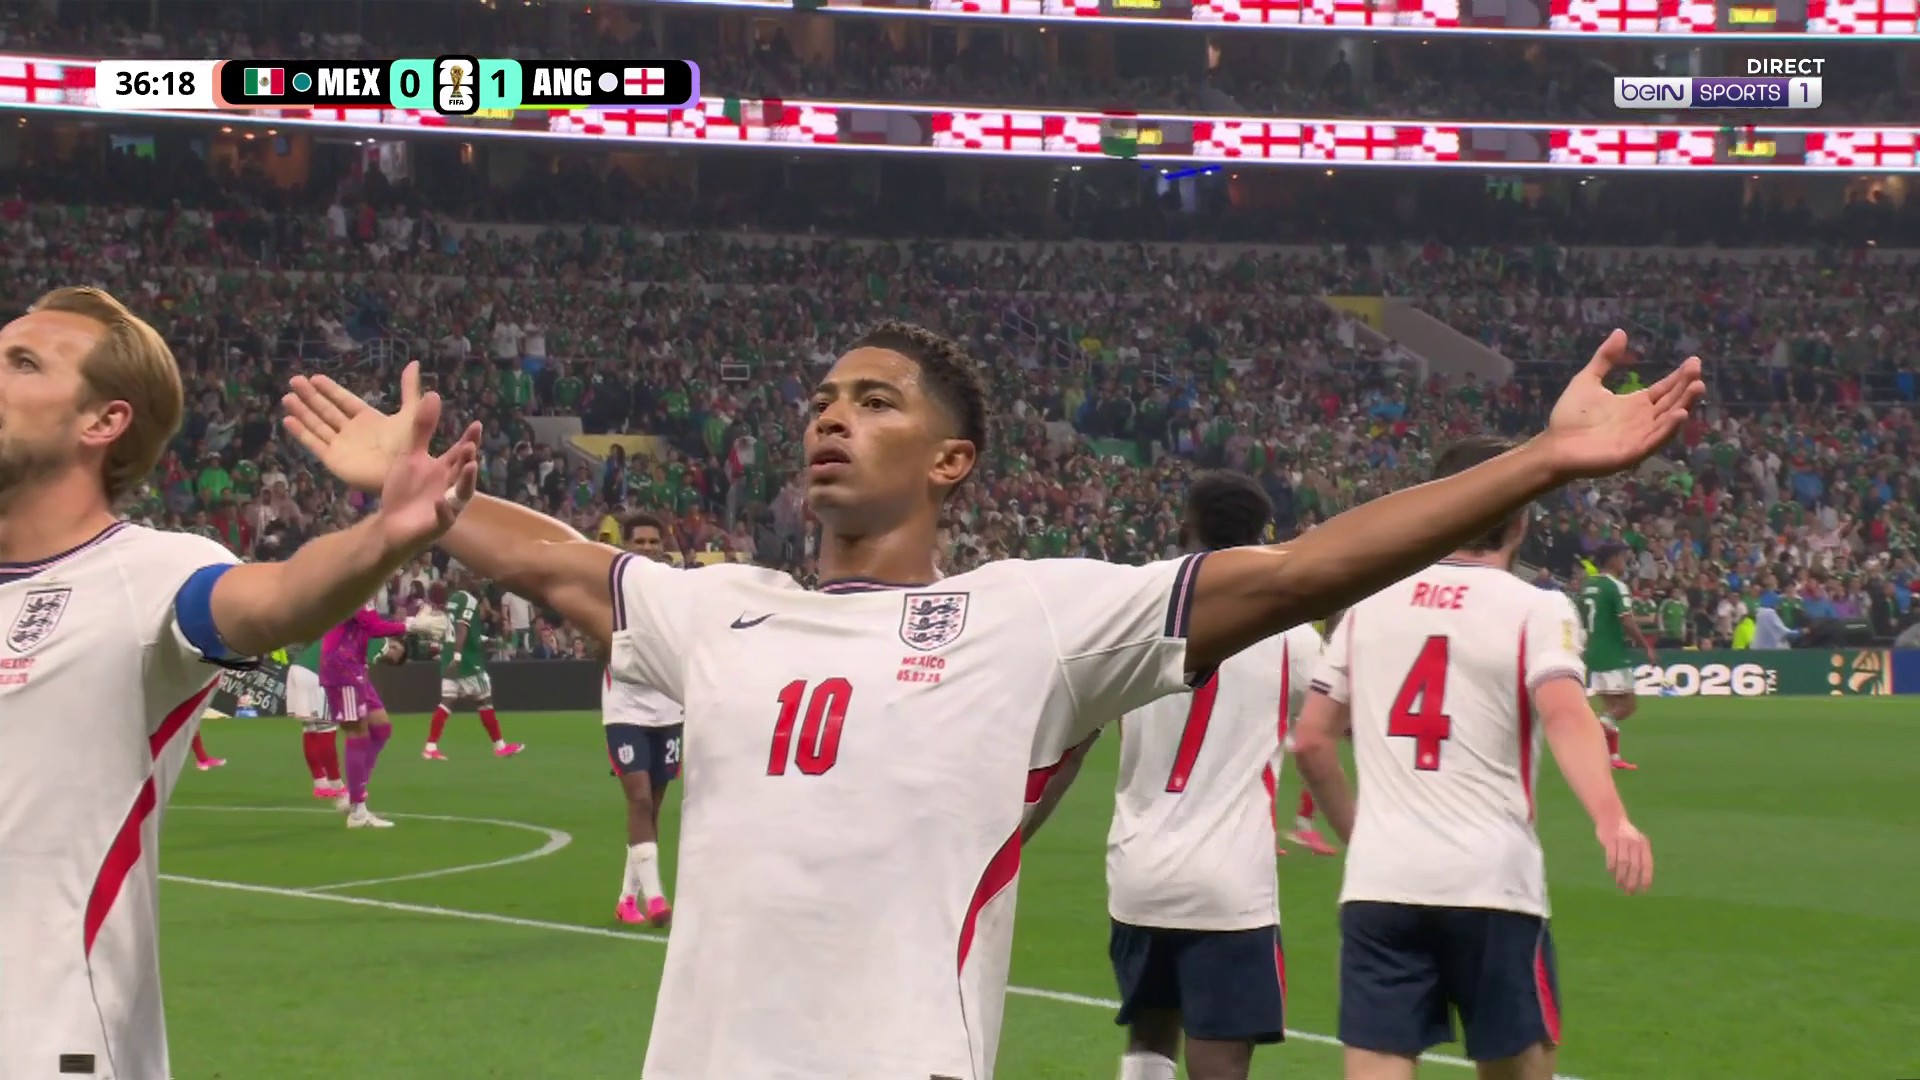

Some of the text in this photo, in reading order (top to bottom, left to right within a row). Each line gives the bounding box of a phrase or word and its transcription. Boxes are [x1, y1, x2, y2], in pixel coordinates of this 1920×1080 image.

[1410, 582, 1469, 609] RICE
[901, 655, 946, 669] MEXICO
[1633, 663, 1766, 695] 2026
[1387, 634, 1452, 770] 4
[766, 677, 853, 776] 10
